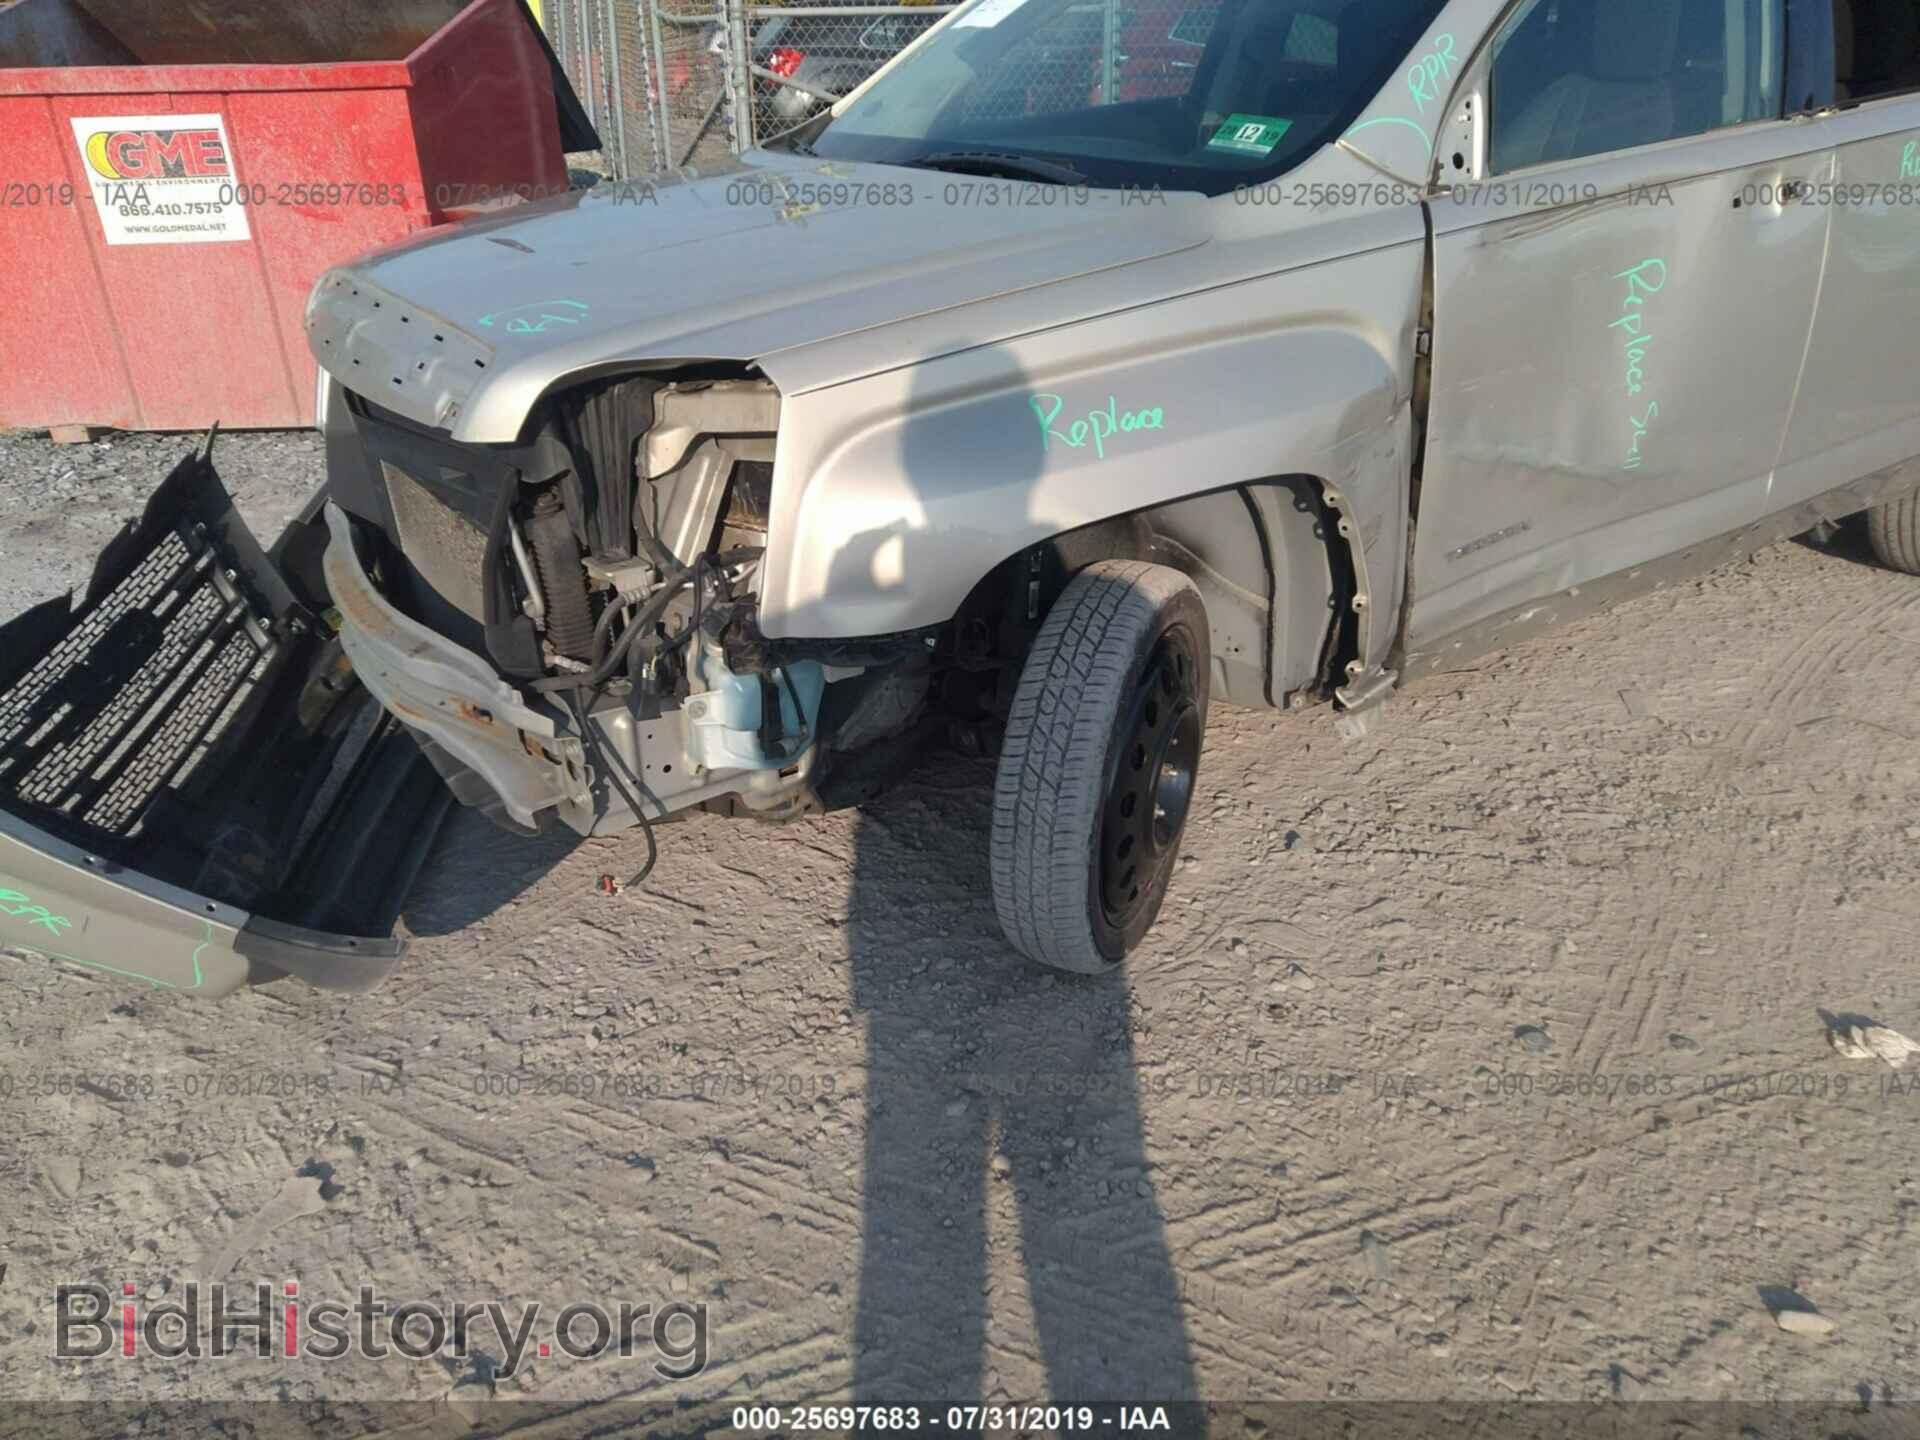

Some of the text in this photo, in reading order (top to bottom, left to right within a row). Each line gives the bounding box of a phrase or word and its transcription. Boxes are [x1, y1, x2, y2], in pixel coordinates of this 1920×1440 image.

[1239, 126, 1261, 140] 12
[107, 130, 230, 179] GME
[119, 202, 223, 217] 866.410.7575
[1029, 393, 1164, 459] Replace
